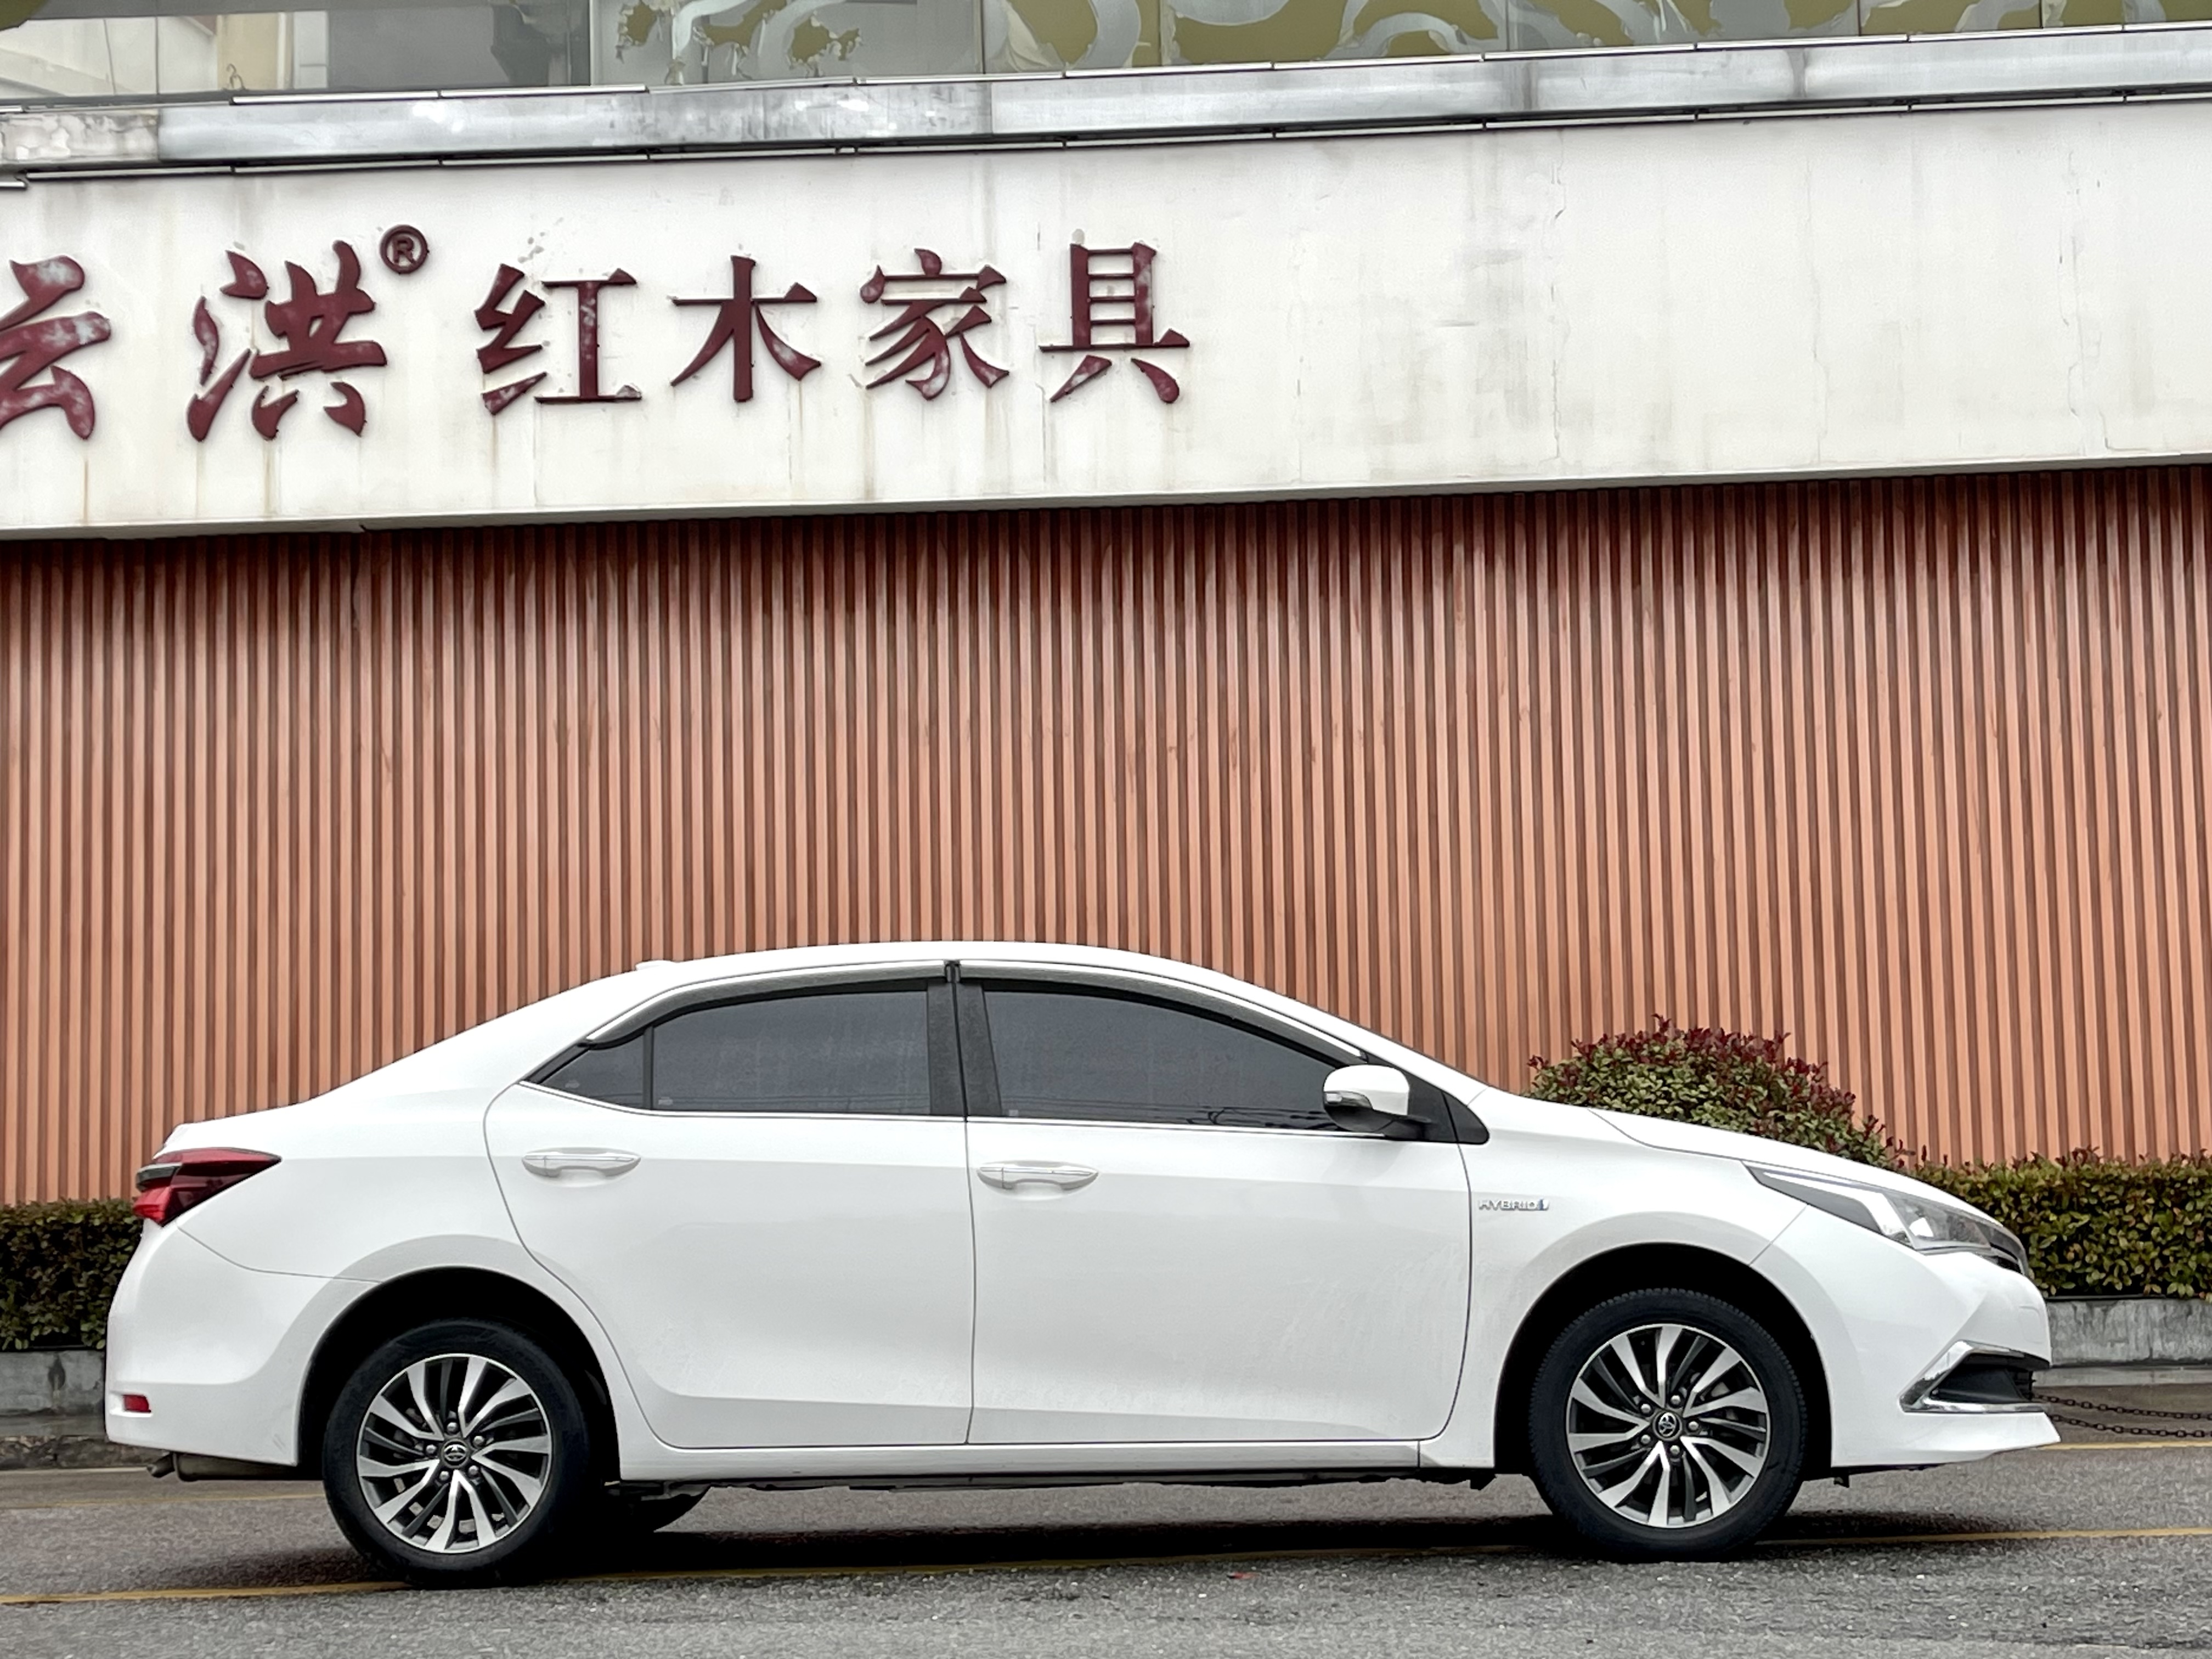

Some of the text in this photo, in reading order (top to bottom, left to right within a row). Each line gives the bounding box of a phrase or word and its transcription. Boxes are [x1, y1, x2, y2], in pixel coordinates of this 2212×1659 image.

[475, 242, 1190, 416] 红木家具
[1478, 1199, 1537, 1211] HYBRID
